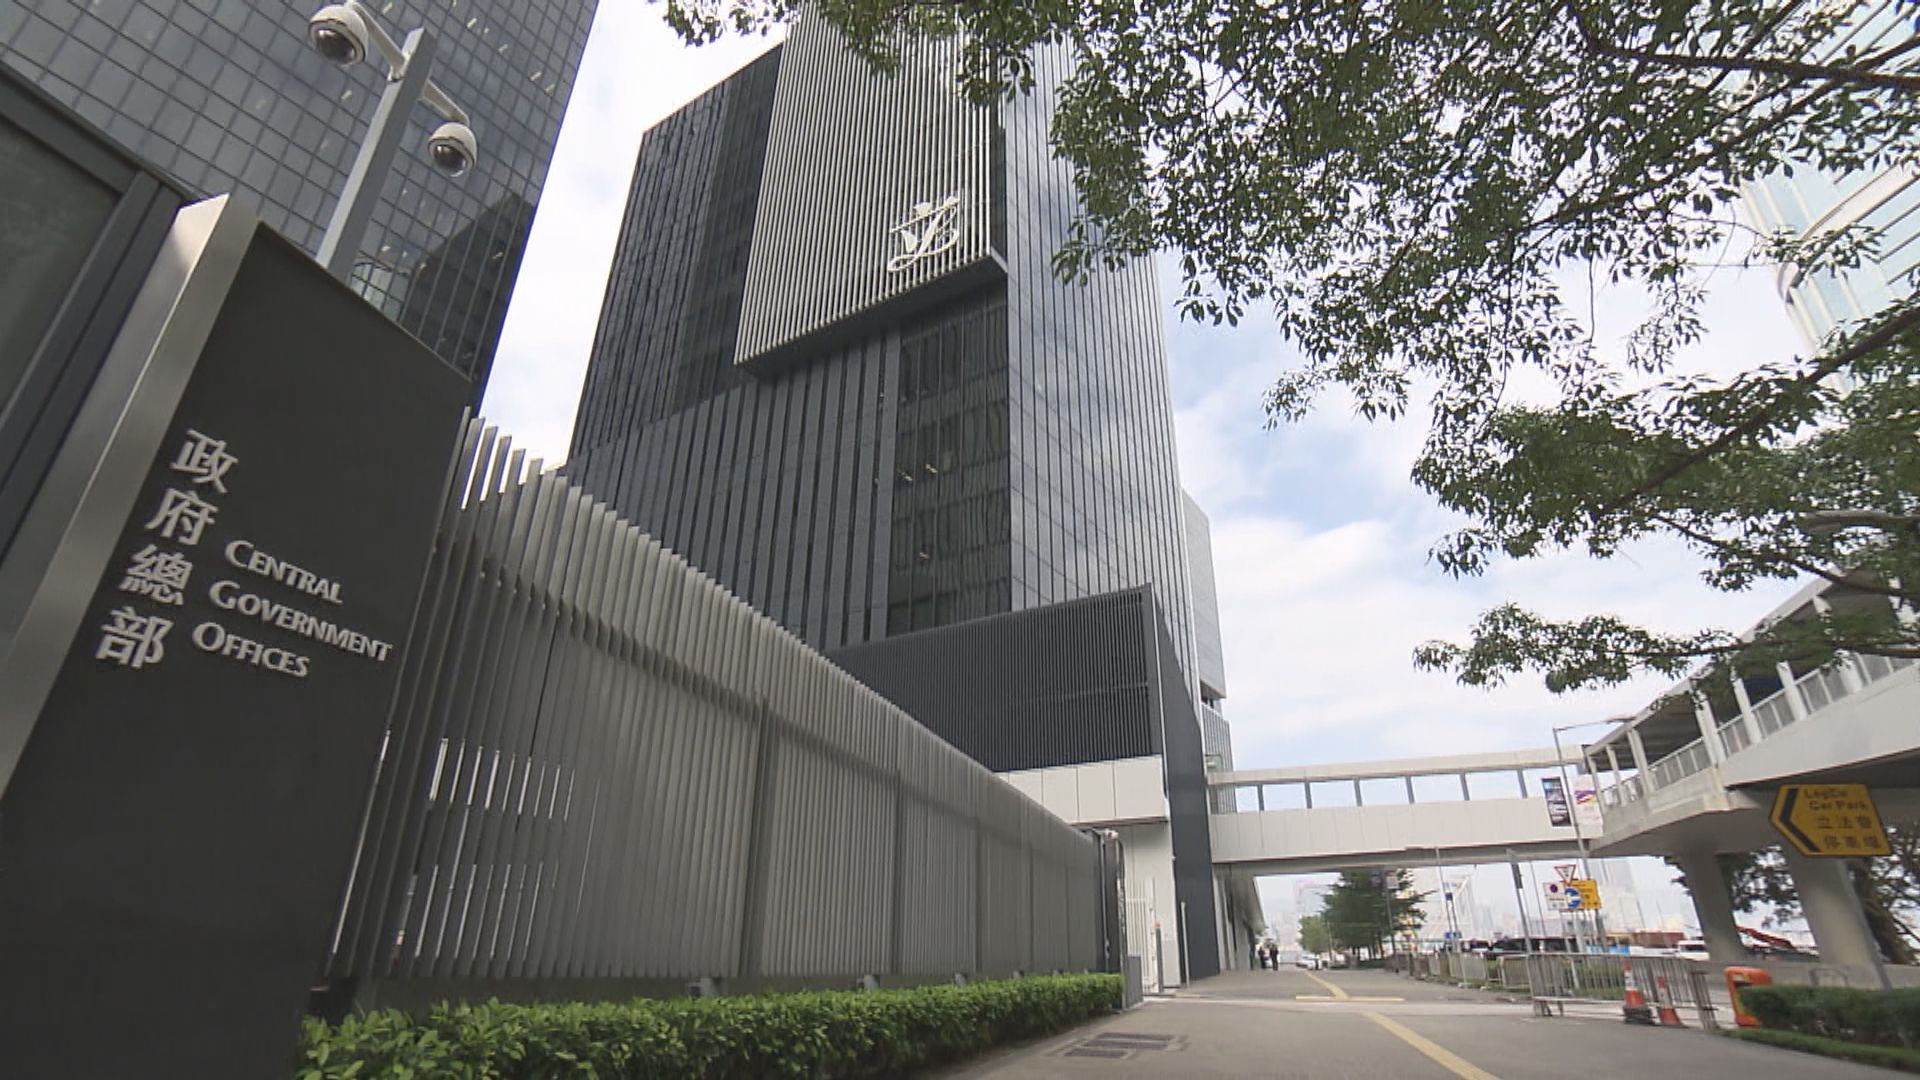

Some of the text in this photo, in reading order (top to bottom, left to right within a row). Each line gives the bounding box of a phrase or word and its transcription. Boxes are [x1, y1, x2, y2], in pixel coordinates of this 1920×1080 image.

[96, 428, 239, 669] 政府總部
[224, 539, 343, 604] CENTRAL
[191, 621, 310, 678] OFFICES
[208, 580, 393, 662] GOVERNMENT
[1808, 799, 1868, 810] Car Park
